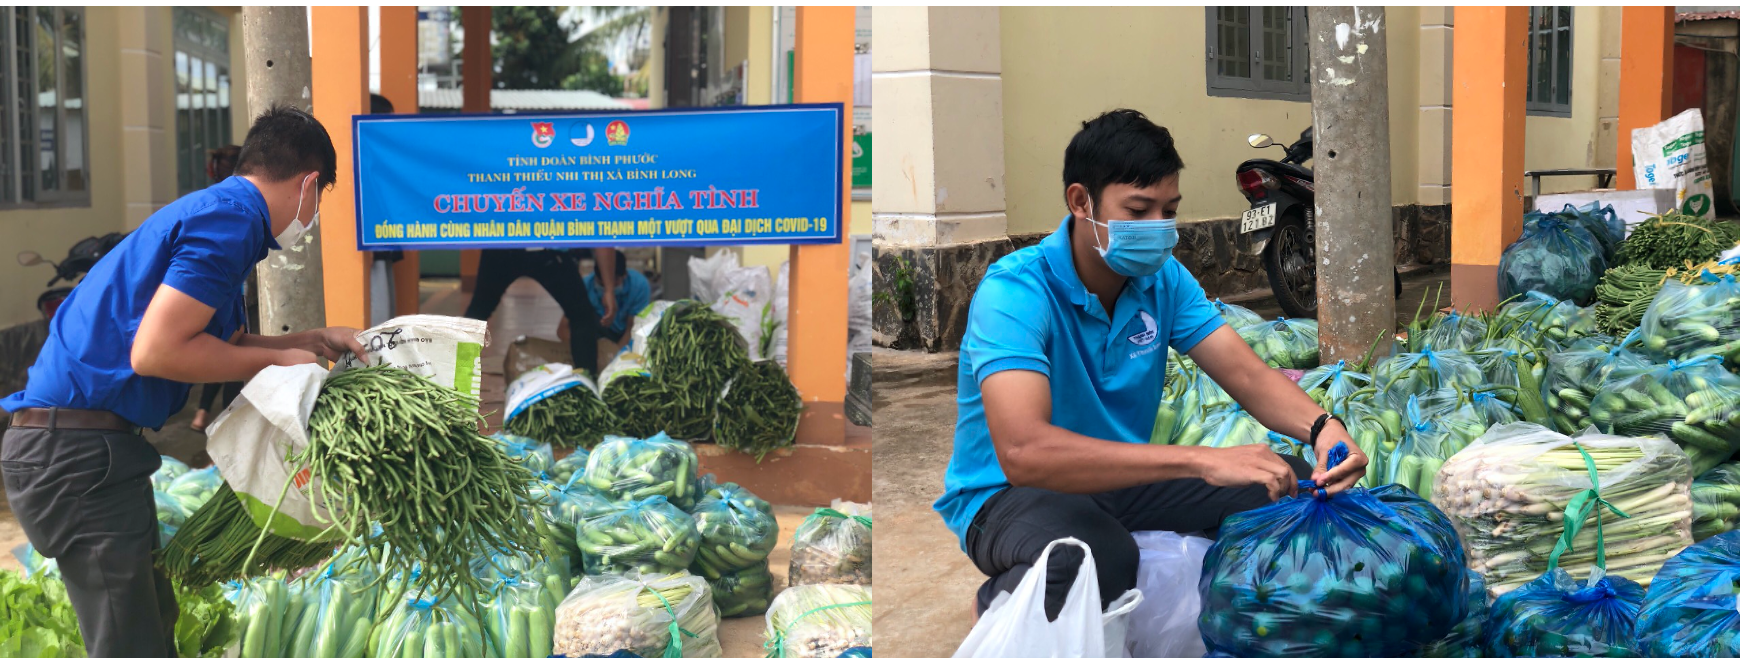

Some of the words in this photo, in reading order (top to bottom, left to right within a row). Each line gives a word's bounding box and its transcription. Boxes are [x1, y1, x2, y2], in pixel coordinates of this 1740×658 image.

[541, 155, 576, 166] ĐOÀN
[580, 155, 610, 164] BÌNH
[468, 173, 510, 182] THANH
[514, 169, 552, 181] THIẾU
[557, 172, 578, 180] NHI
[582, 172, 603, 181] THỊ
[627, 169, 657, 179] BÌNH
[662, 170, 696, 178] LONG
[434, 186, 545, 213] CHUYẾN
[550, 193, 586, 211] XE
[593, 187, 684, 210] NGHĨA
[689, 185, 759, 209] TÌNH
[407, 221, 437, 238] HÀNH
[440, 221, 470, 238] CÙNG
[473, 220, 504, 237] NHÂN
[508, 220, 531, 237] DÂN
[534, 219, 564, 239] QUẬN
[568, 219, 594, 236] BÌNH
[597, 221, 634, 238] THẠNH
[638, 218, 662, 238] MỘT
[665, 219, 693, 237] VƯỢT
[696, 220, 719, 235] QUA
[722, 219, 741, 236] ĐẠI
[745, 218, 771, 236] DỊCH
[775, 217, 827, 232] COVID-19
